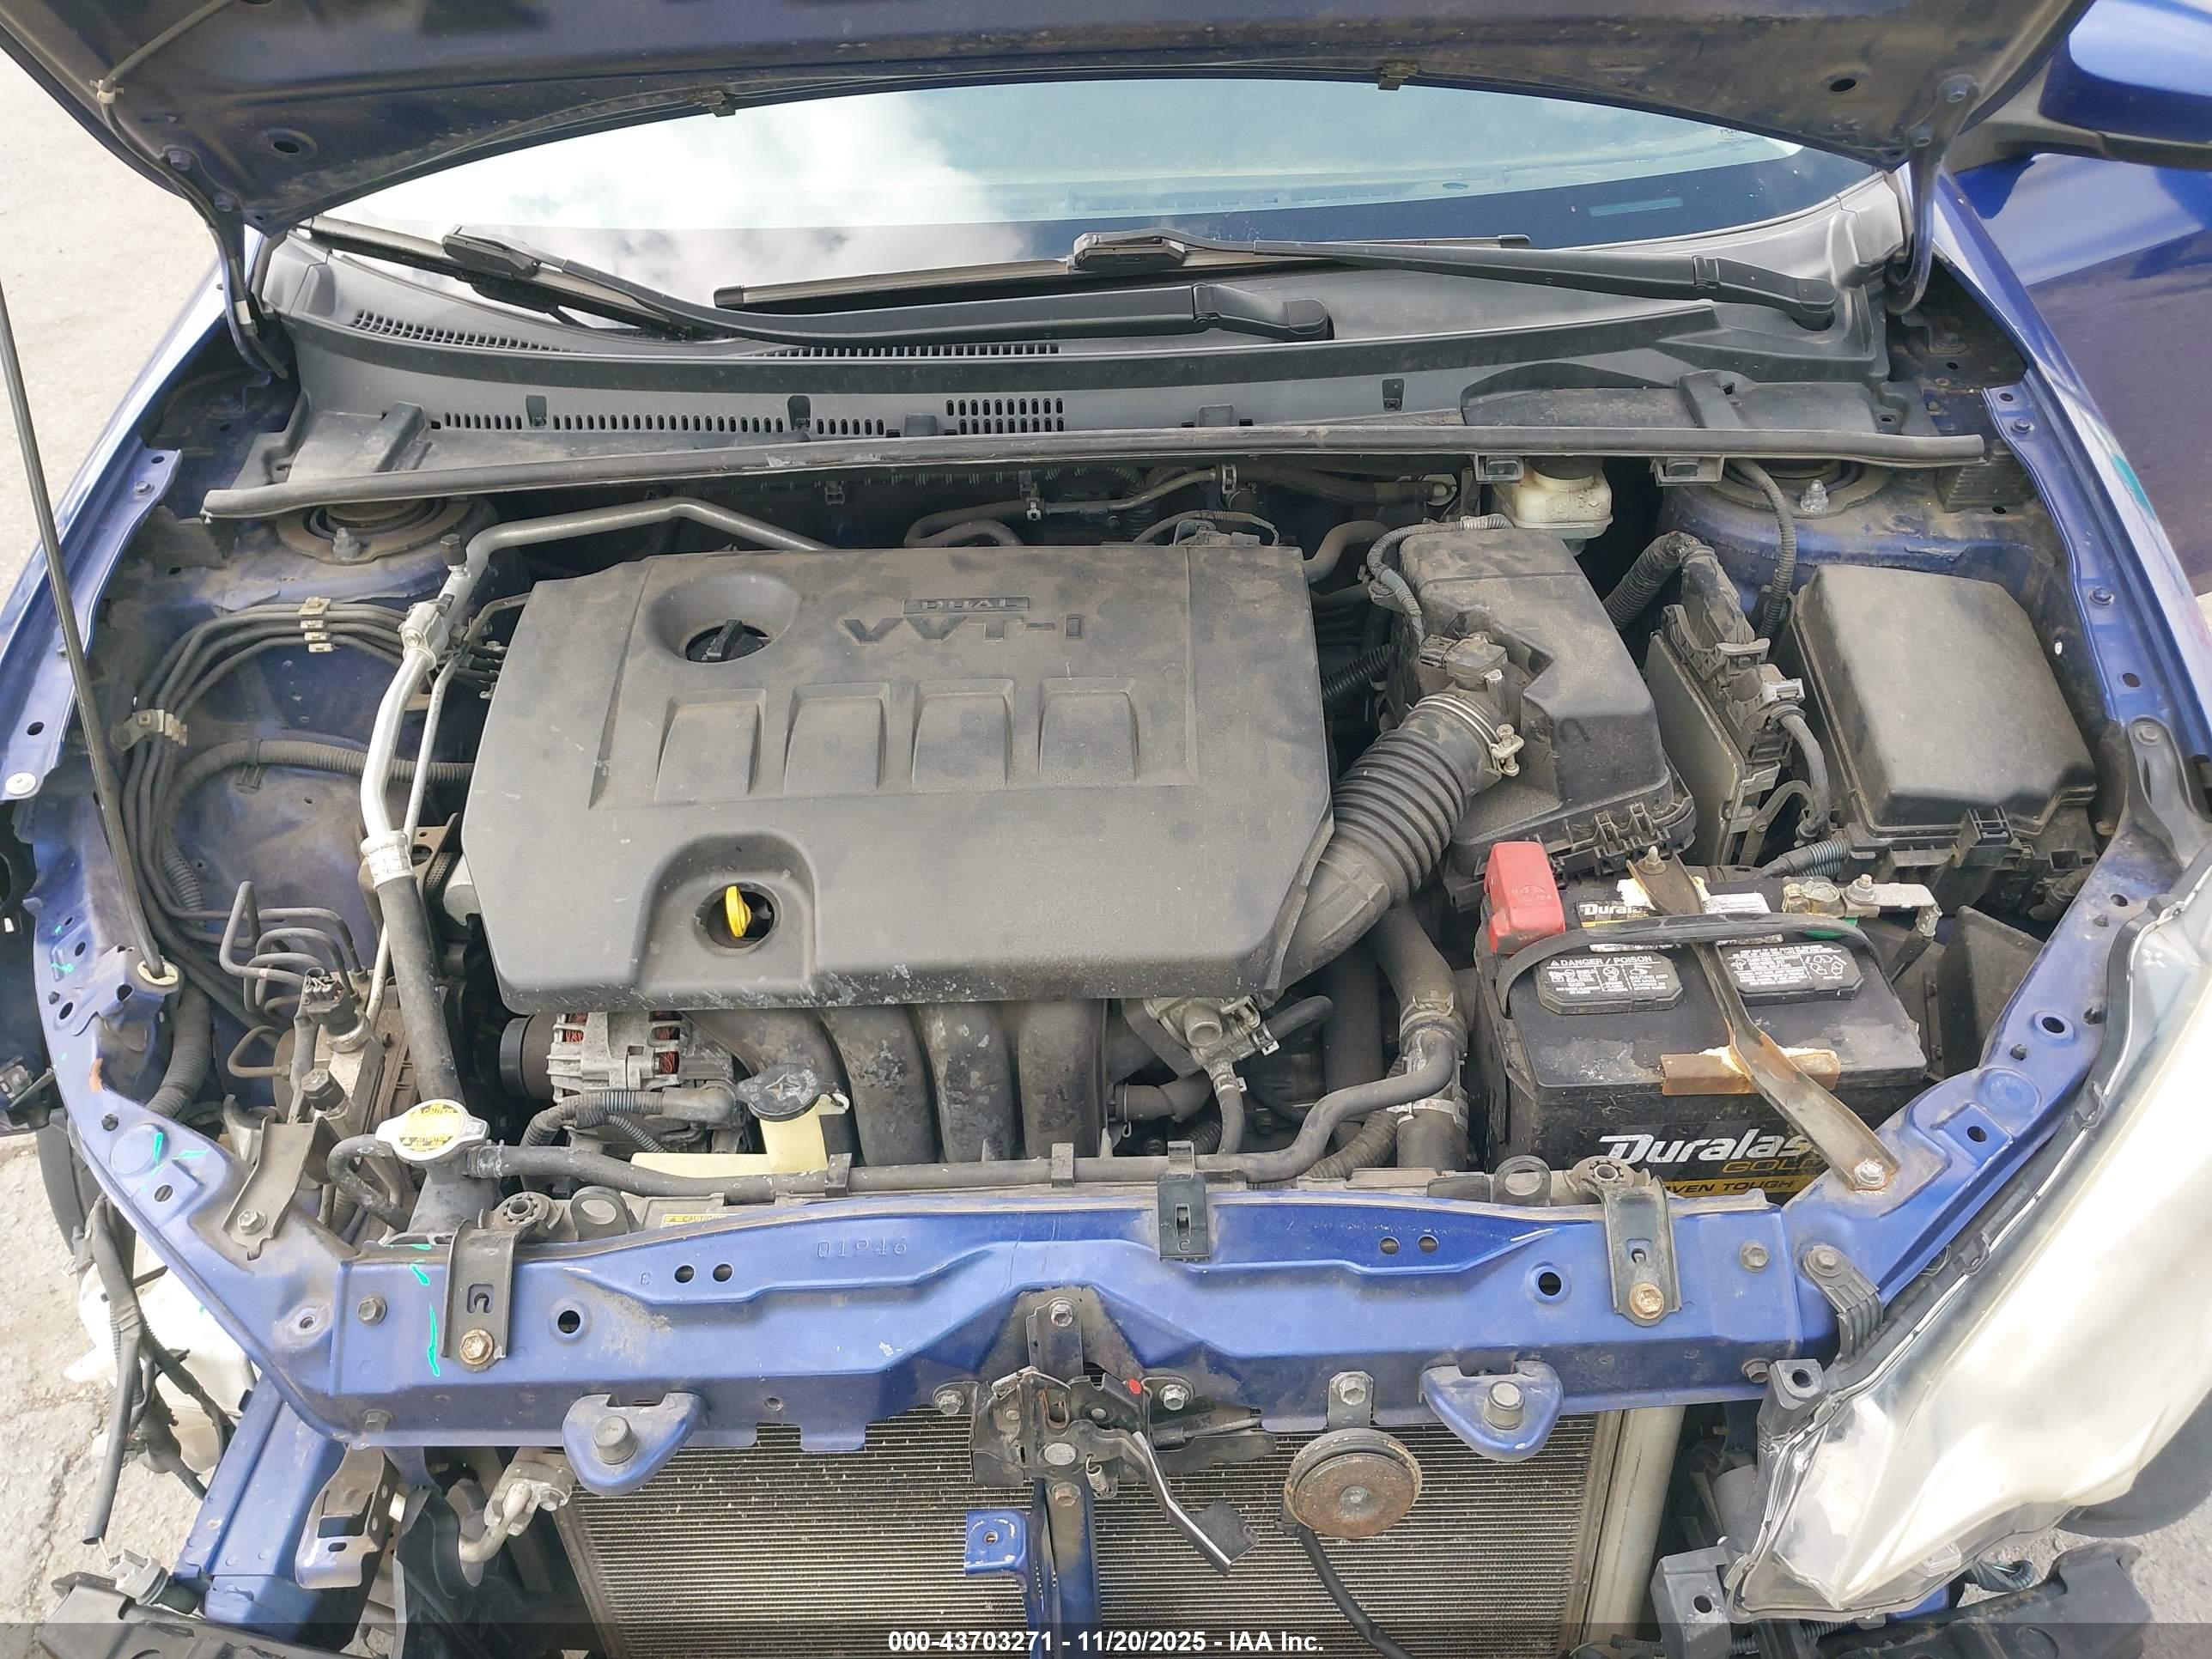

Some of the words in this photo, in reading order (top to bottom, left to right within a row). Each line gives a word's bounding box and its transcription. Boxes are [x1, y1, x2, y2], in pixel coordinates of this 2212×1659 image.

[921, 598, 1018, 611] DUAL
[1561, 957, 1603, 966] DANGER
[1599, 1127, 1813, 1164] Duralas
[1665, 1184, 1716, 1193] VEN
[1723, 1180, 1796, 1191] TOUGH
